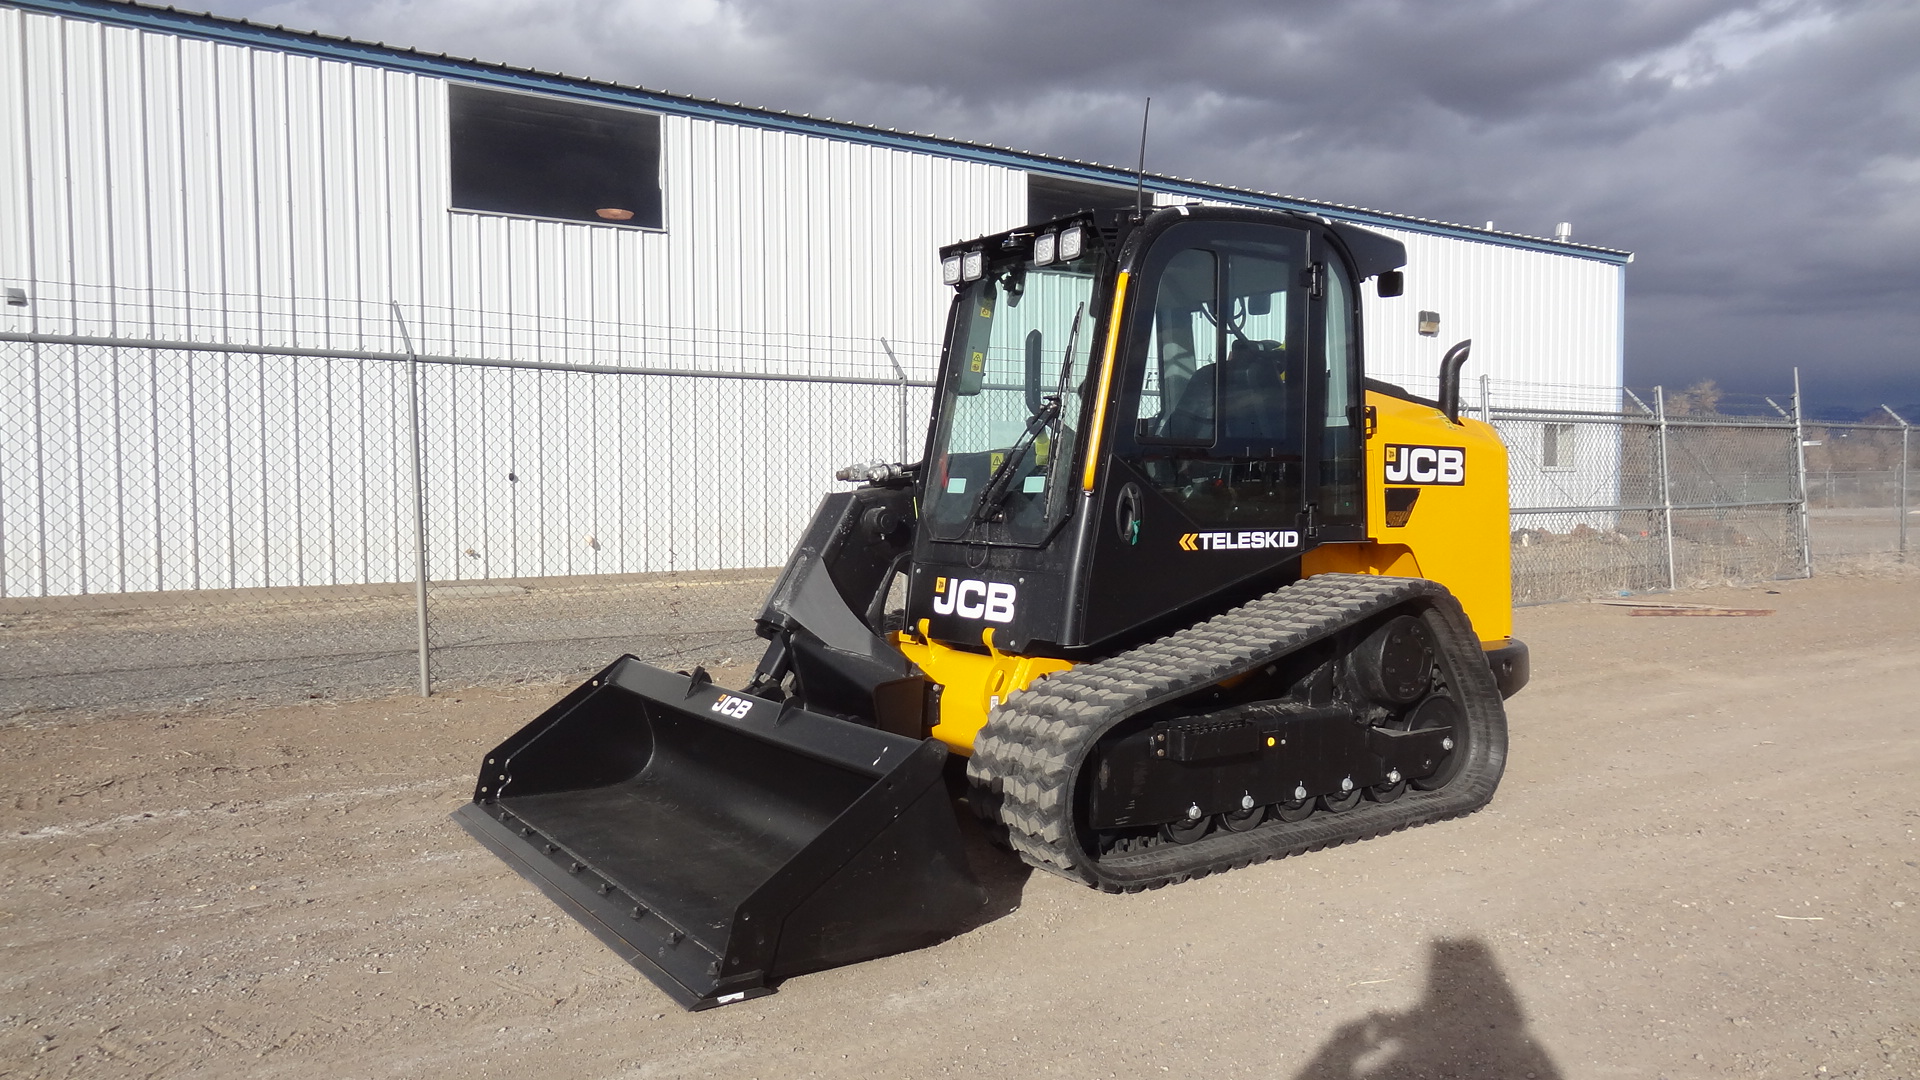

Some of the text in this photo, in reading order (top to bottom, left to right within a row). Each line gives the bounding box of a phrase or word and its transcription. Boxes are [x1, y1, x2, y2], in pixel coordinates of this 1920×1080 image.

[1385, 447, 1464, 483] JCB
[1198, 530, 1299, 550] TELESKID
[933, 575, 1017, 624] JCB
[711, 695, 754, 719] JCB
